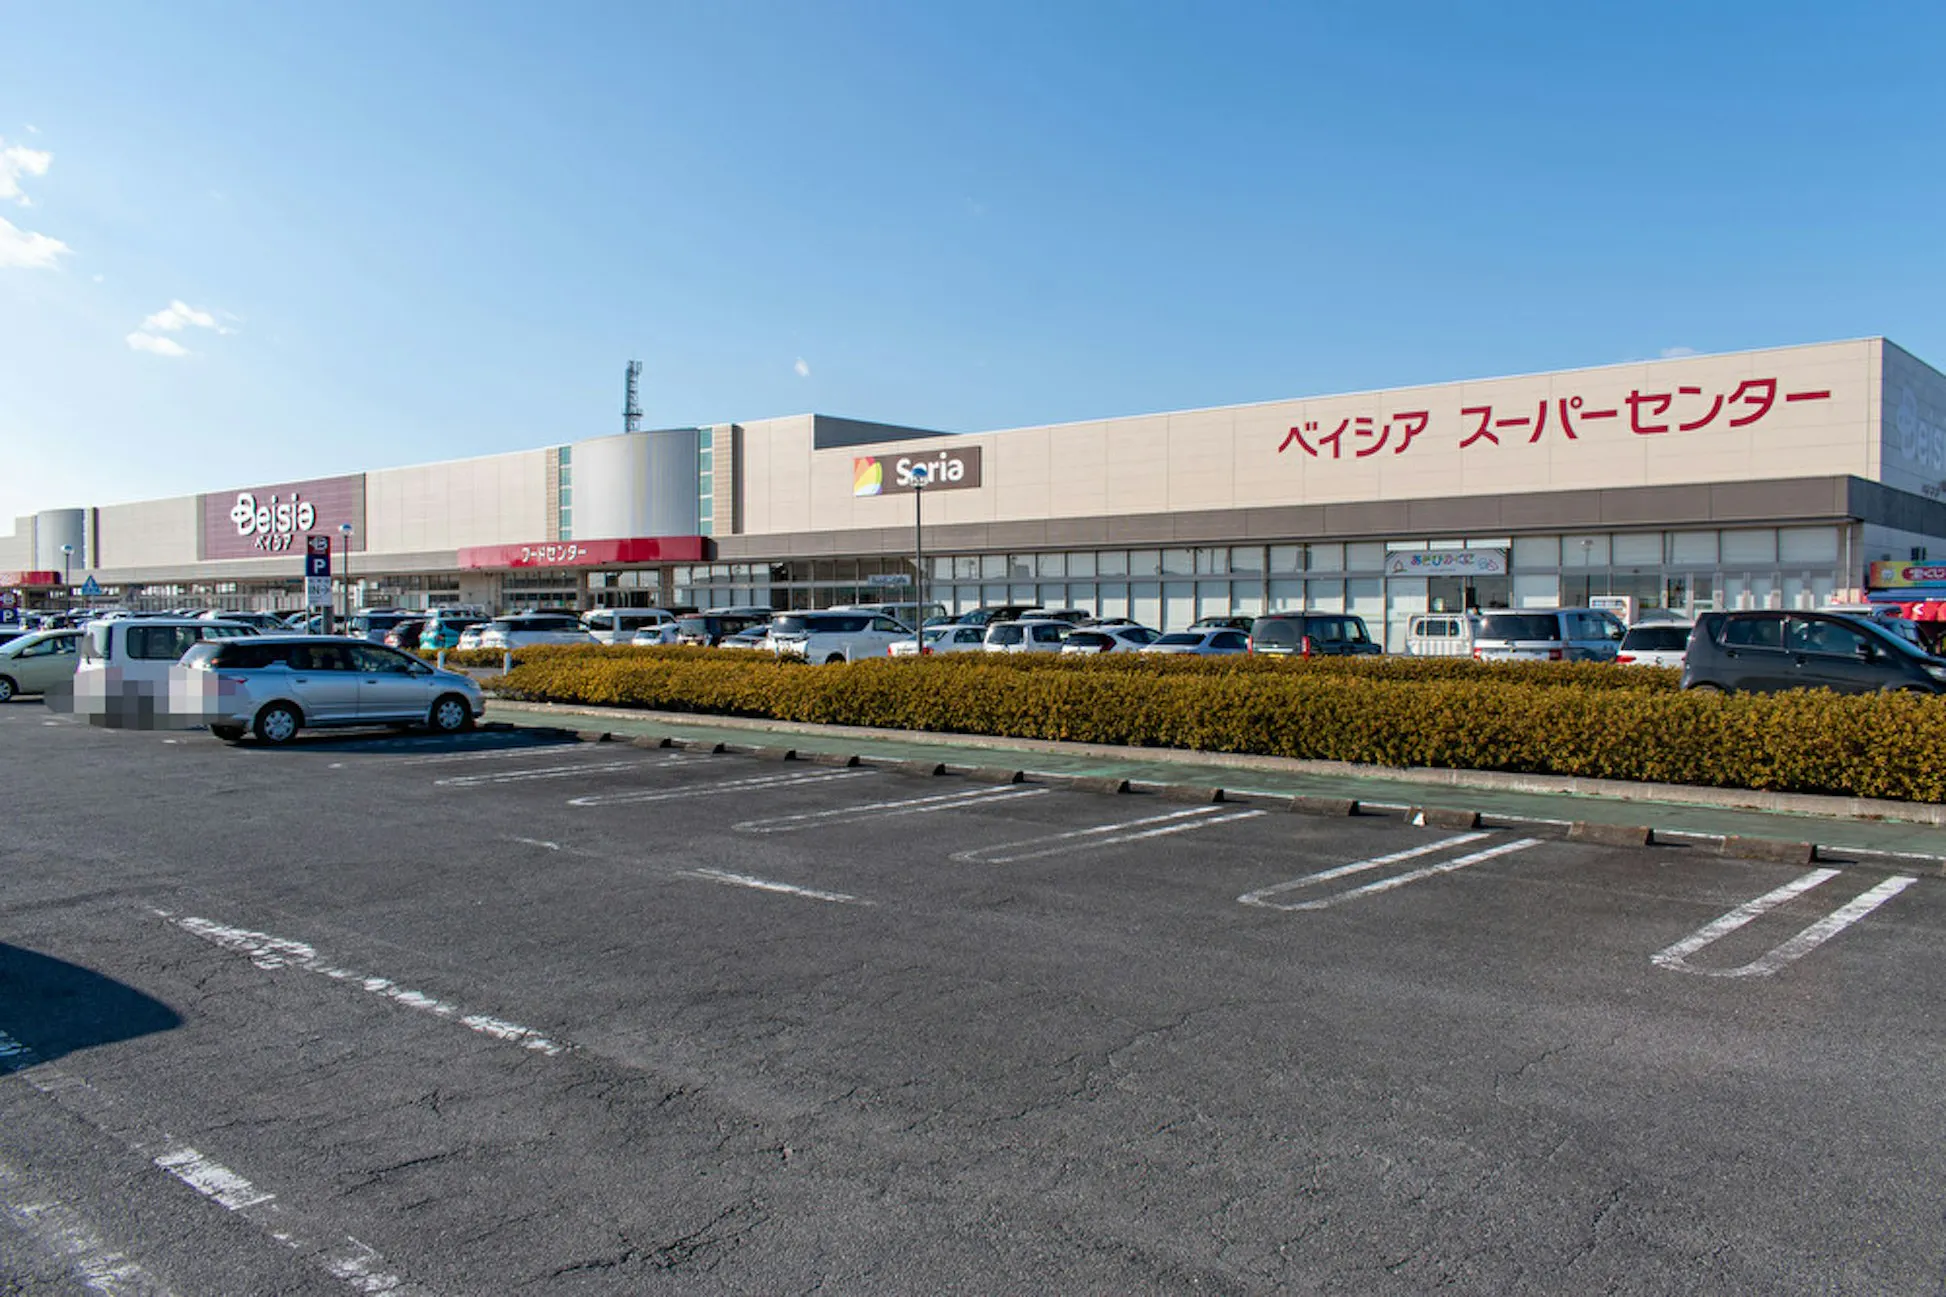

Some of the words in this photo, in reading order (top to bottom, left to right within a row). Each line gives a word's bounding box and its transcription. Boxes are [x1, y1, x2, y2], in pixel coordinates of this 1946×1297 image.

[1278, 411, 1429, 458] ベイシア
[1459, 377, 1831, 448] スーパーセンター
[1896, 386, 1946, 472] Beis
[230, 492, 315, 535] Beisia
[313, 558, 327, 574] P
[521, 544, 587, 562] フードセンター
[3, 609, 15, 622] P
